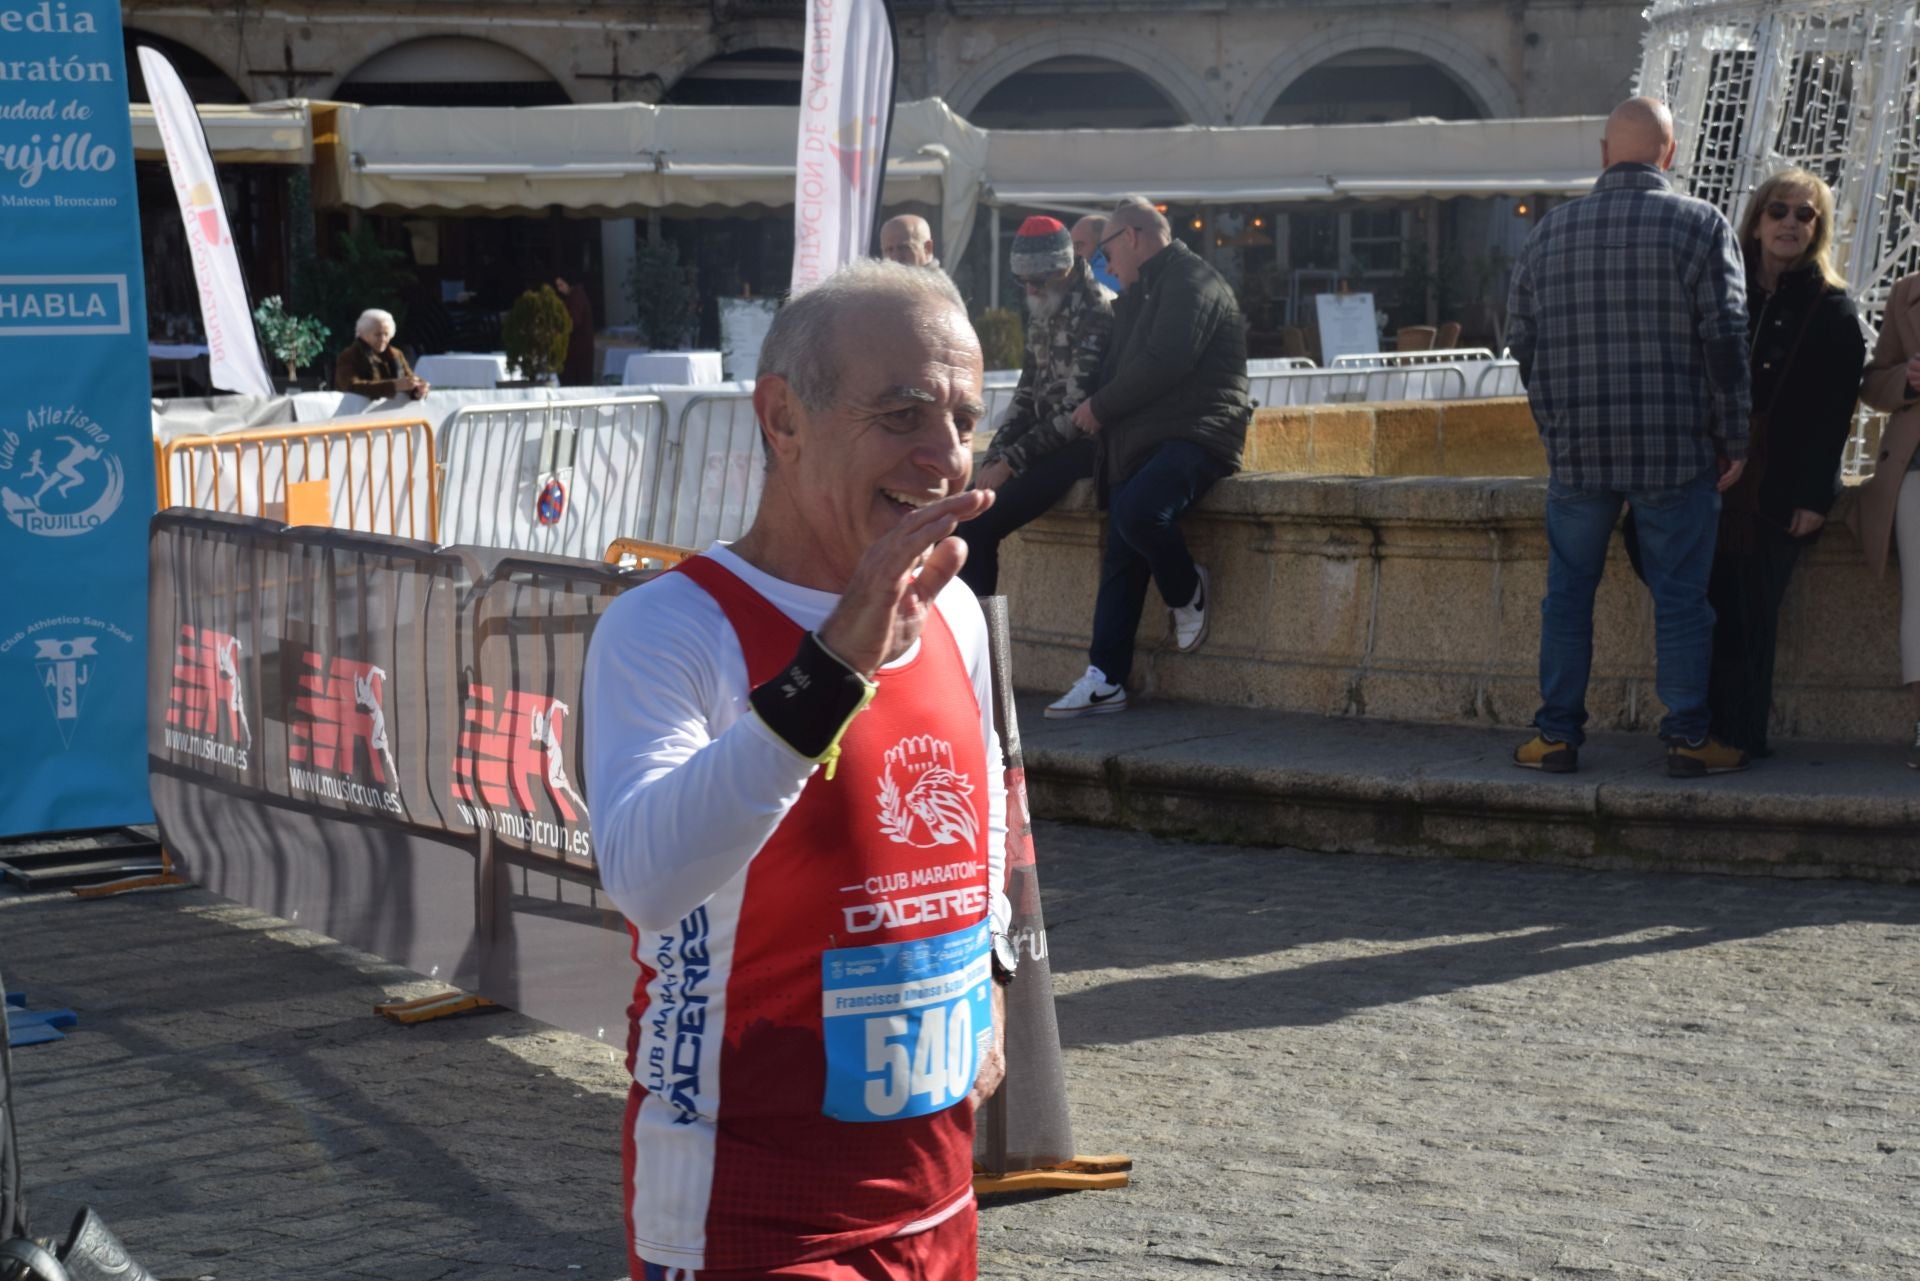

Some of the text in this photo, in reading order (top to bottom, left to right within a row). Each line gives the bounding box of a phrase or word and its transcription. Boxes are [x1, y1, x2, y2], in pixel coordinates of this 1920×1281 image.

[61, 99, 93, 120] de
[1, 194, 117, 206] Mateos Broncano
[0, 293, 107, 318] HABLA
[27, 404, 110, 443] Atletismo
[13, 508, 101, 531] TRUJILLO
[0, 631, 25, 652] Club
[83, 616, 105, 629] San
[107, 624, 134, 643] José
[164, 728, 248, 770] www.musicrun.es
[289, 766, 402, 814] www.musicrun.es
[457, 804, 590, 856] www.musicrun.es
[865, 861, 977, 895] CLUB MARATON
[835, 992, 900, 1009] Francisco
[648, 1045, 665, 1098] LUB
[864, 998, 971, 1116] 540
